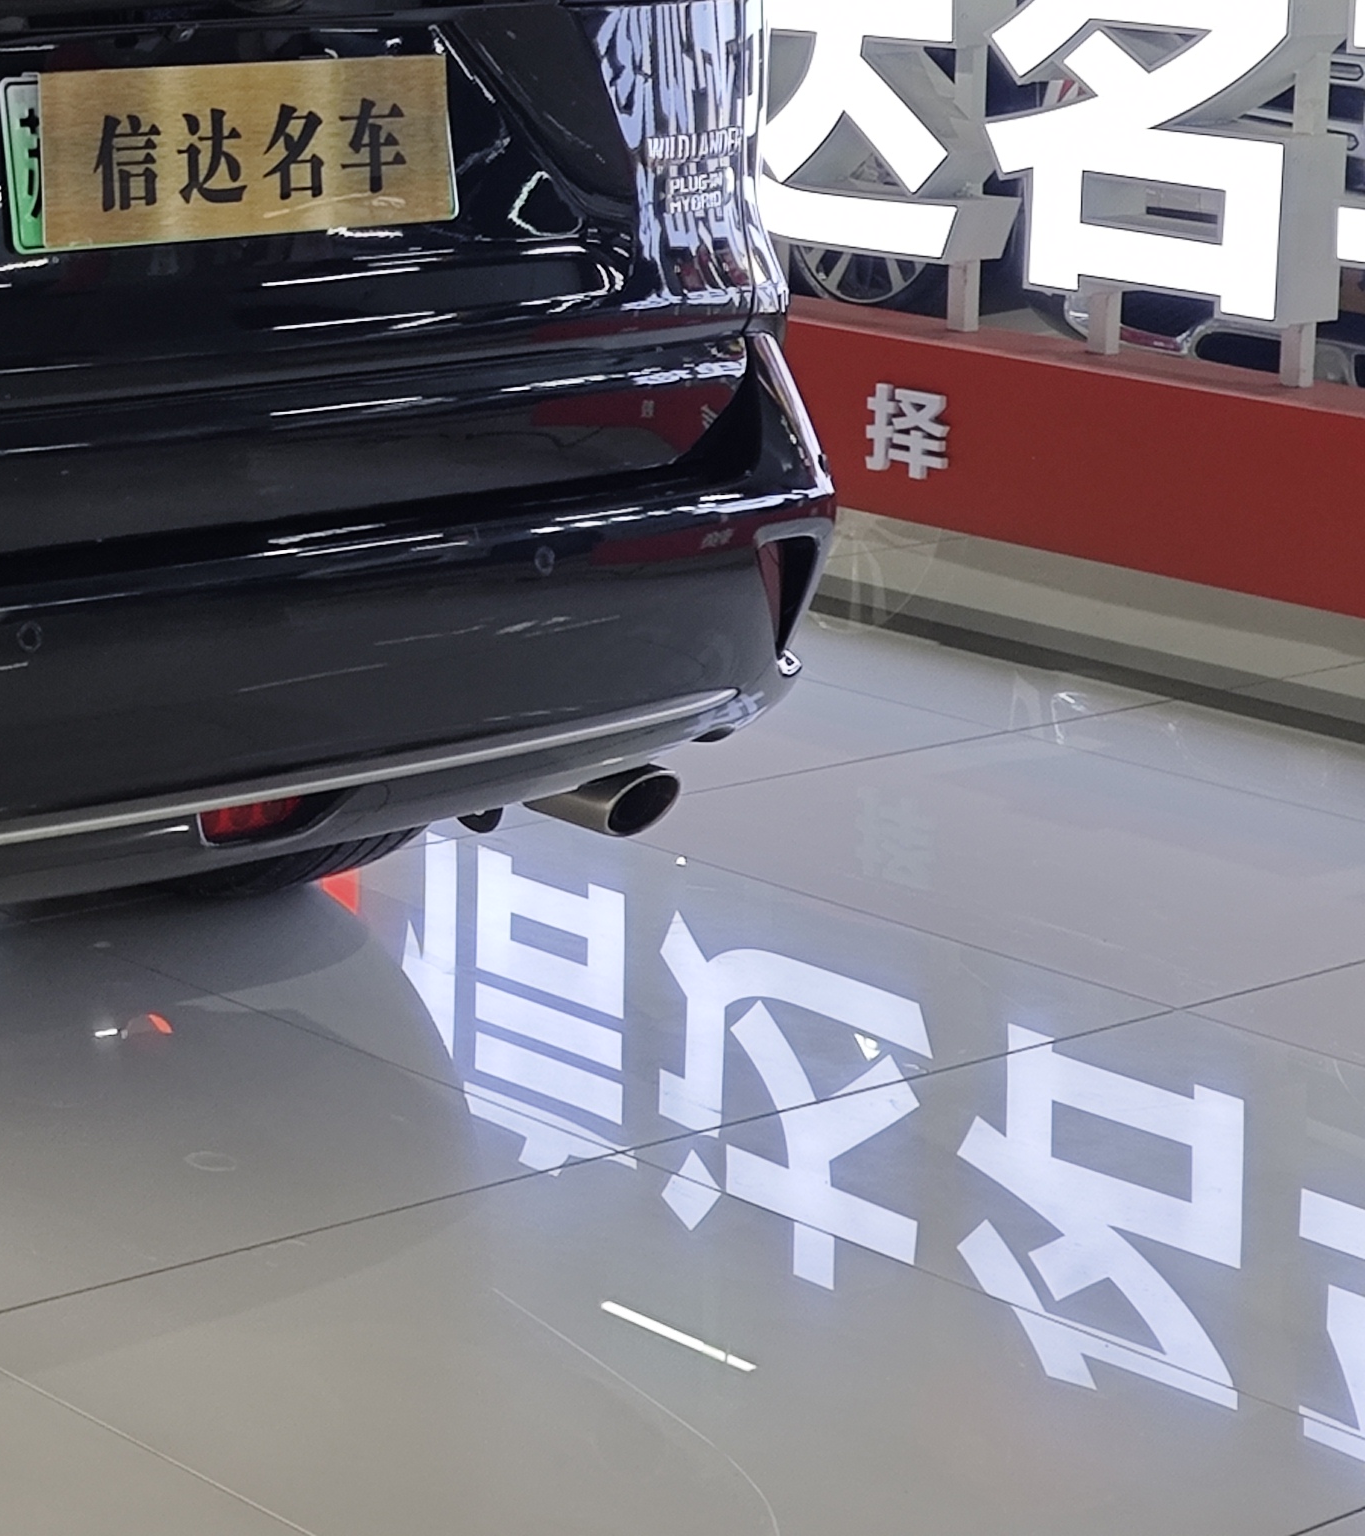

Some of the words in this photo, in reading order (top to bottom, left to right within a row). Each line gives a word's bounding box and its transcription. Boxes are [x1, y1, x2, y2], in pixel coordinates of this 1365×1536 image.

[92, 96, 408, 212] 信达名车
[647, 126, 742, 161] WILDLANDER
[865, 382, 949, 478] 择
